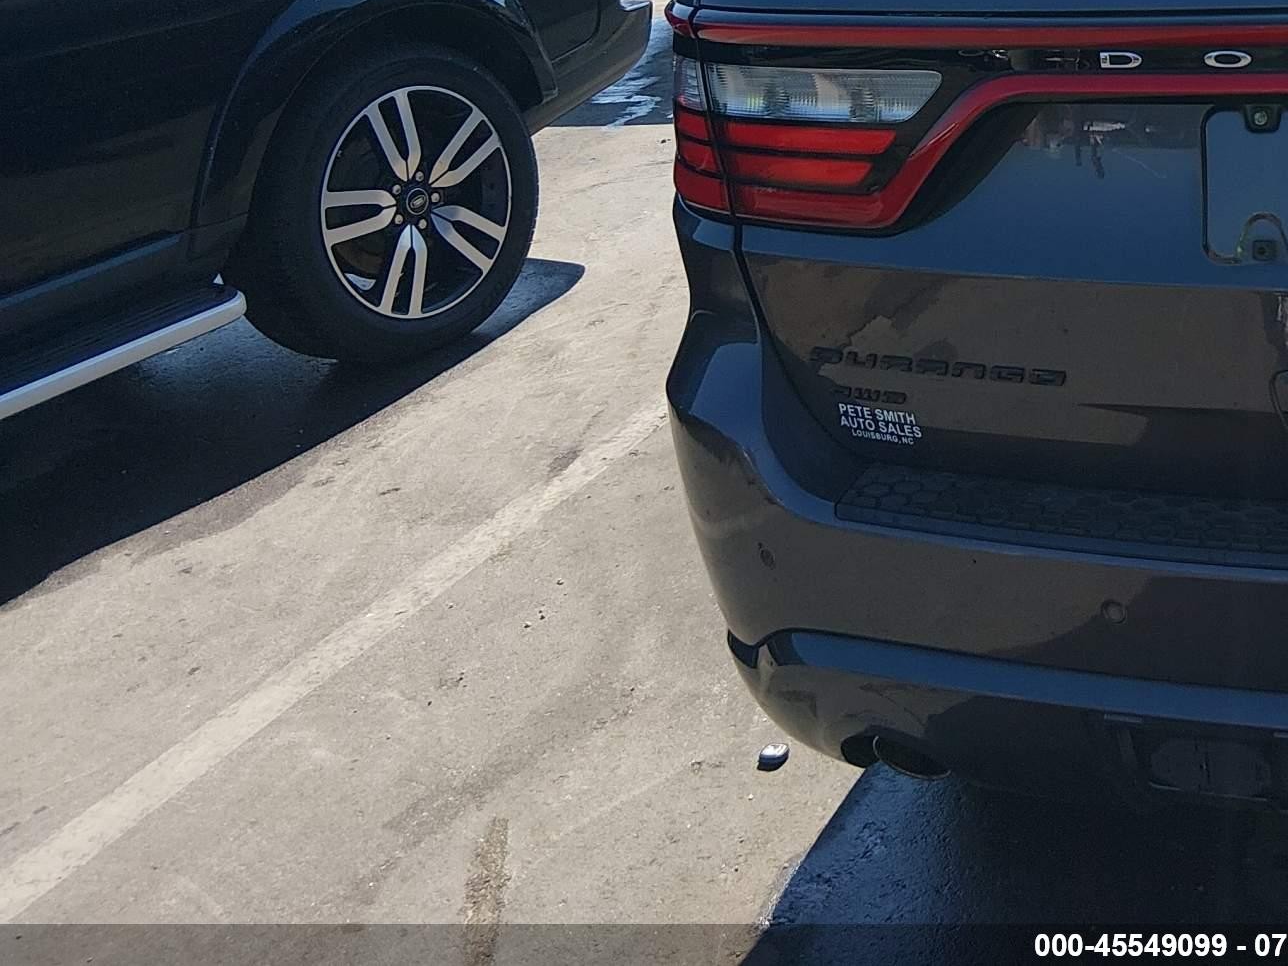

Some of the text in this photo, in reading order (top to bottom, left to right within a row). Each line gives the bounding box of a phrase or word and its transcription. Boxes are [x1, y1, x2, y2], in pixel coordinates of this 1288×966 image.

[809, 346, 1067, 386] DURANGO
[838, 403, 917, 425] PETE SMITH
[840, 415, 922, 438] AUTO SALES
[902, 437, 915, 445] NC
